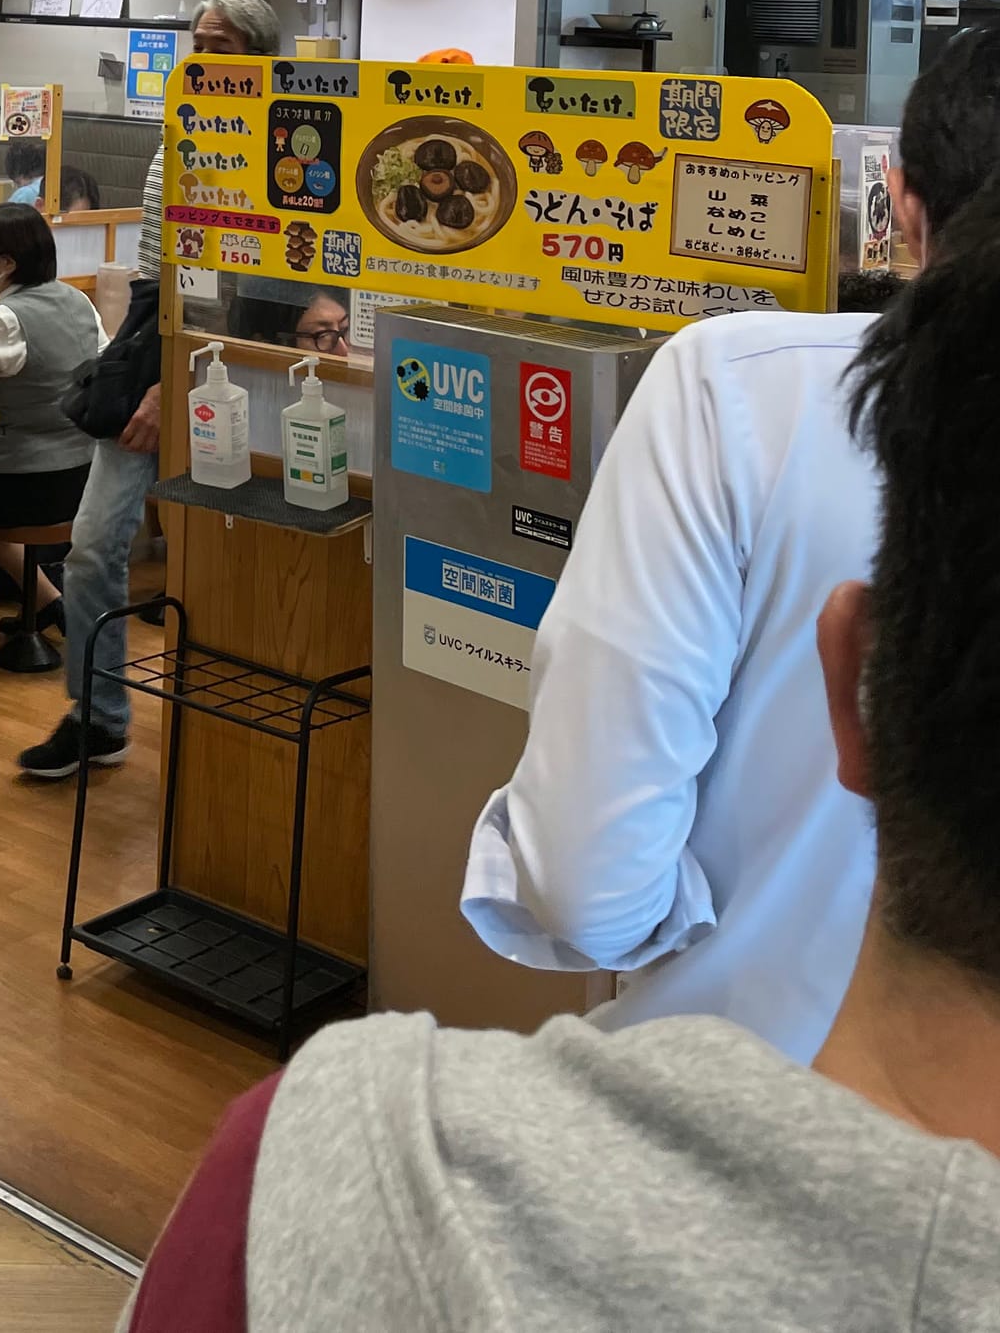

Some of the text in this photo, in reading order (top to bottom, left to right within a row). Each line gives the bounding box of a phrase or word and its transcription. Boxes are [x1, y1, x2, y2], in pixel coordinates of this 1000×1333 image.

[663, 80, 722, 109] 期間
[661, 109, 720, 139] 限定
[685, 162, 801, 187] おすすめのトッピング
[167, 209, 279, 230] トッピングもできます
[523, 189, 659, 232] うどん・そば
[707, 206, 768, 224] なめこ
[708, 223, 767, 241] しめじ
[221, 250, 261, 266] 150円
[541, 233, 625, 263] 570円
[365, 257, 542, 289] 店内でのお食事のみとなります
[562, 266, 776, 306] 風味豊かな味わいを
[433, 361, 485, 404] UVC
[432, 397, 485, 421] 空間除菌中
[528, 421, 563, 444] 警告
[515, 509, 533, 524] UVC
[443, 566, 515, 607] 空間除菌
[439, 633, 532, 673] UVC ウイルスキラー
